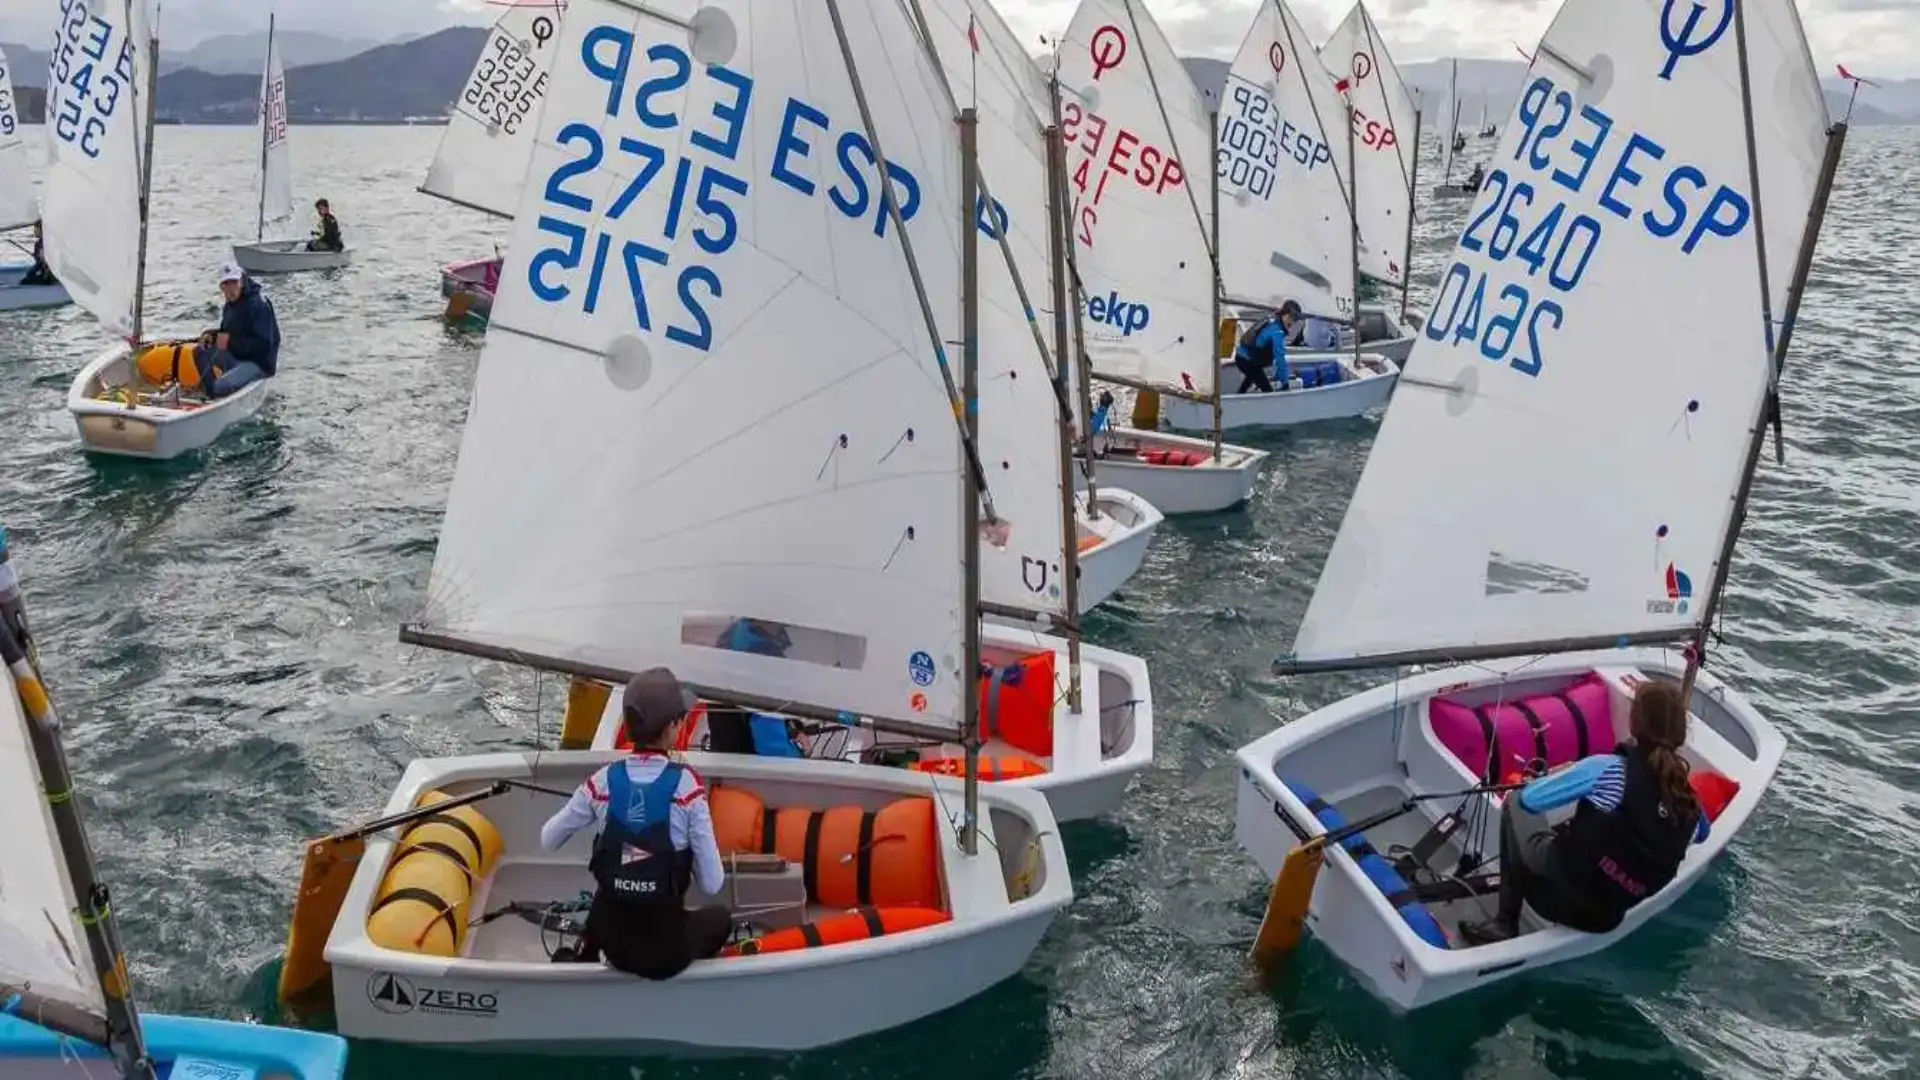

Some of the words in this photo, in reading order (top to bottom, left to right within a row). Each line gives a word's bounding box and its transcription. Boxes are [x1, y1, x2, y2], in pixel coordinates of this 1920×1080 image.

[771, 97, 921, 238] ESP
[1107, 129, 1185, 195] ESP
[1220, 116, 1278, 169] 1003
[1280, 120, 1331, 170] ESP
[544, 123, 749, 255] 2715
[1598, 132, 1751, 256] ESP
[1460, 168, 1601, 293] 2640
[1088, 290, 1149, 337] ekp
[417, 987, 498, 1010] ZERO
